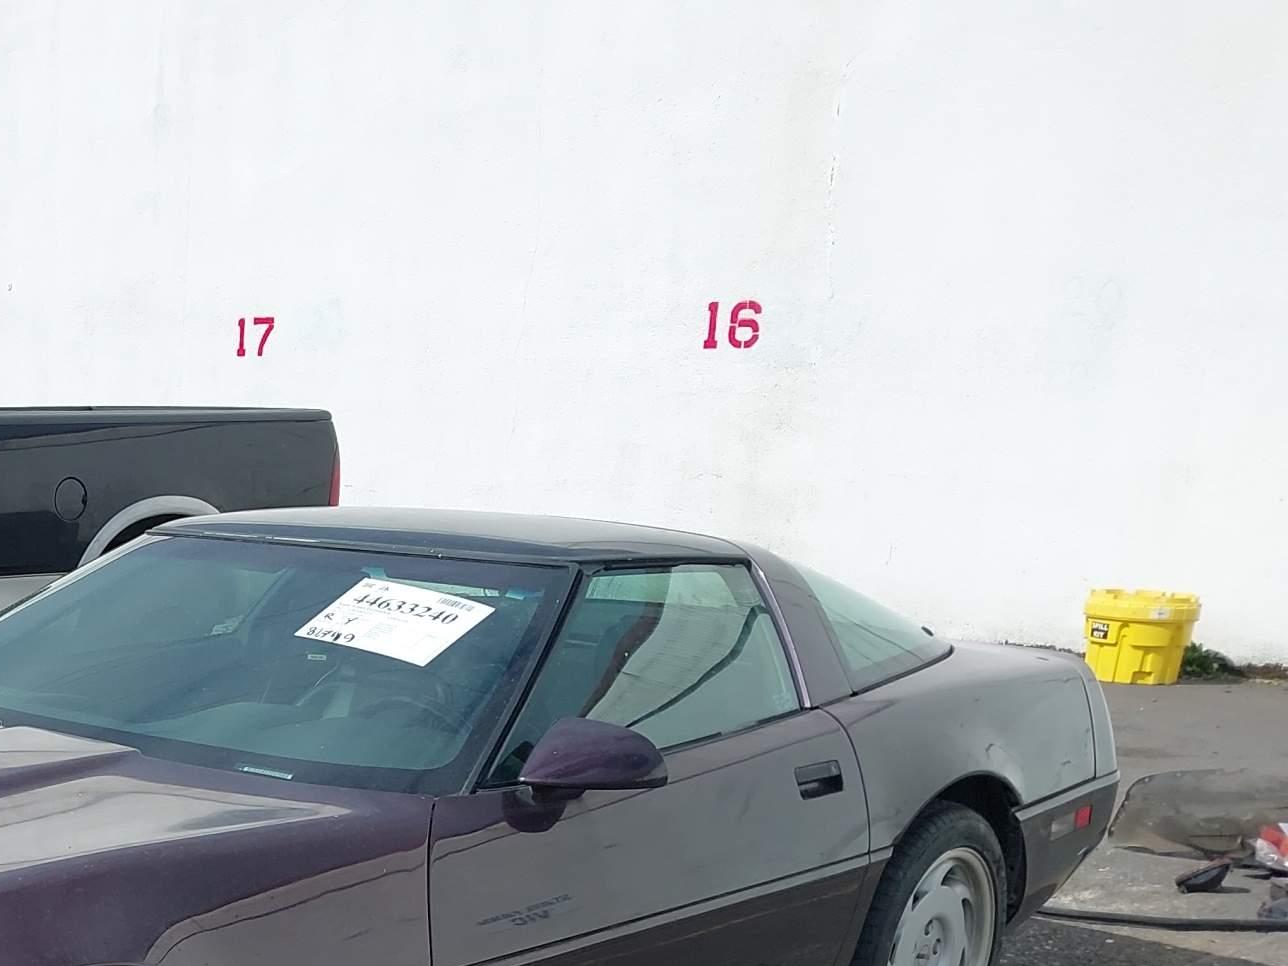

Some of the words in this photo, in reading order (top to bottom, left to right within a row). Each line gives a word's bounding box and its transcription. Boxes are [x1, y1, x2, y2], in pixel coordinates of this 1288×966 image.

[236, 316, 276, 358] 17
[703, 299, 763, 350] 16
[352, 593, 460, 625] 44633240
